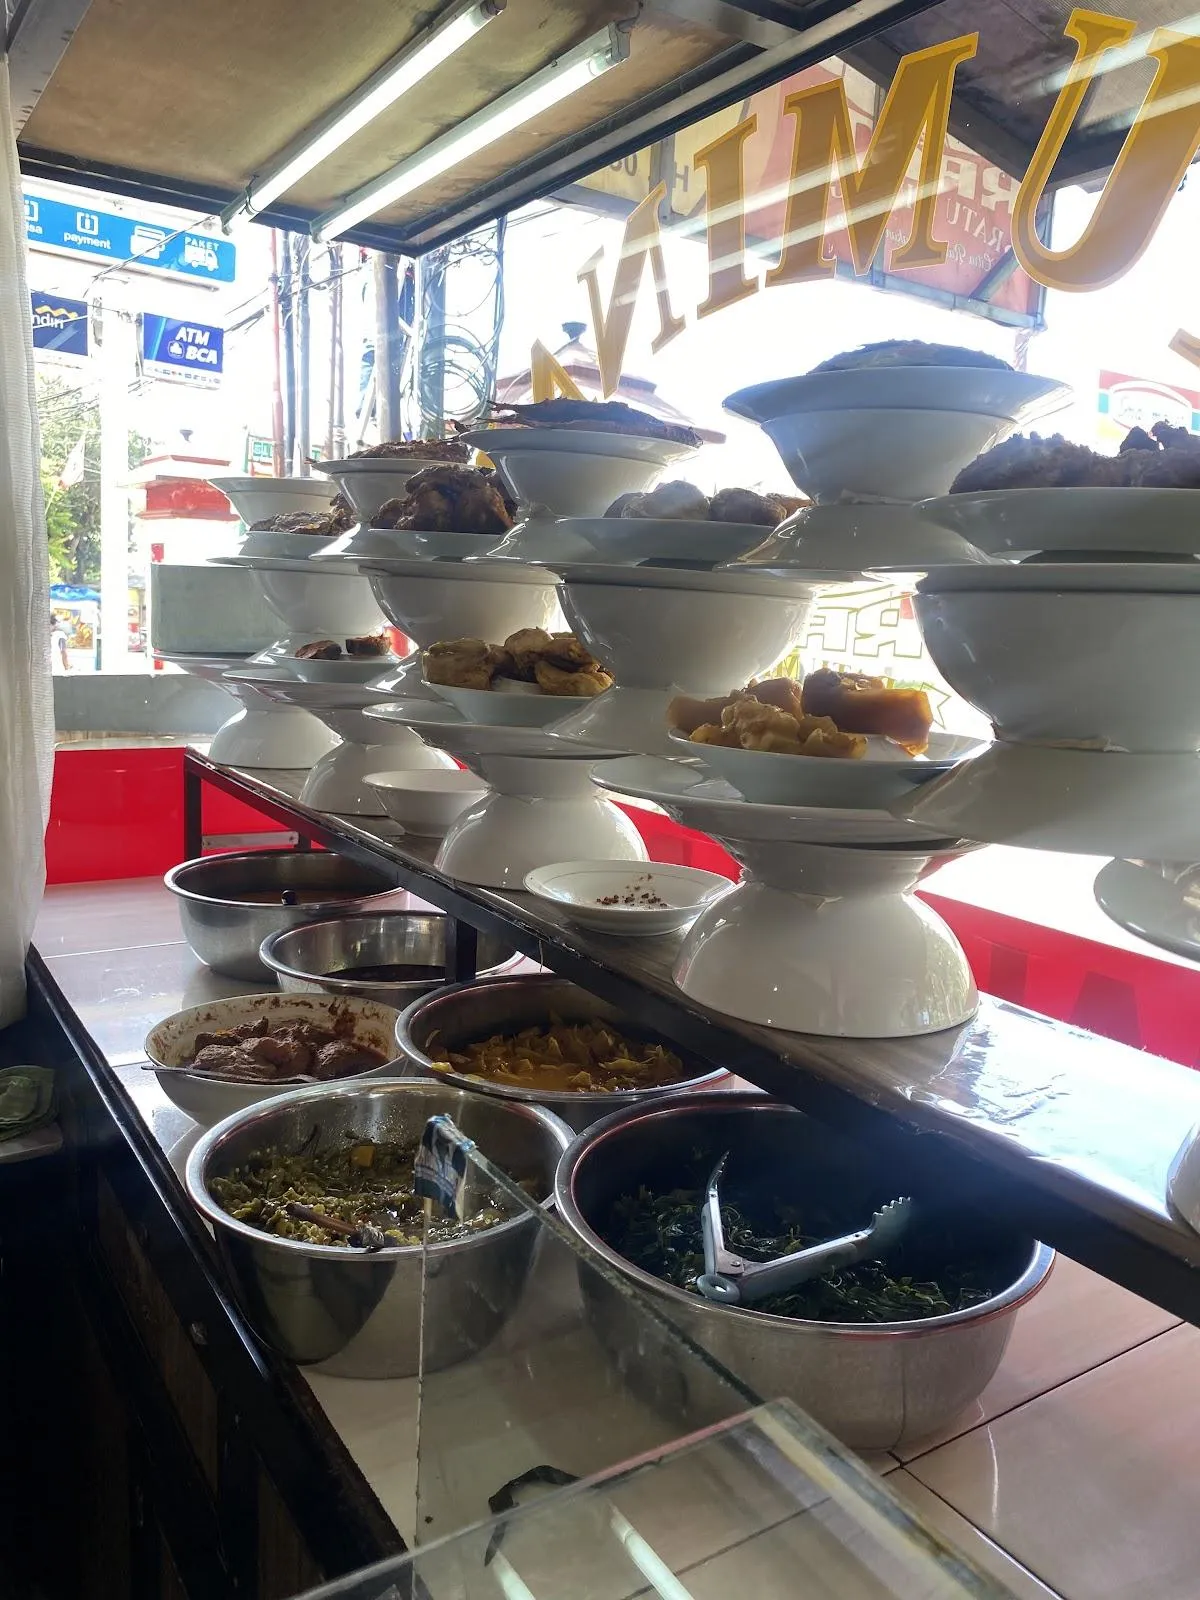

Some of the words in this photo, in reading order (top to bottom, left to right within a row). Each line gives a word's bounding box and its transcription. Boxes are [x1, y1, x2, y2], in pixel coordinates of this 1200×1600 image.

[64, 232, 112, 250] payment
[185, 236, 219, 251] PAKET
[175, 326, 211, 346] ATM
[185, 345, 218, 365] BCA
